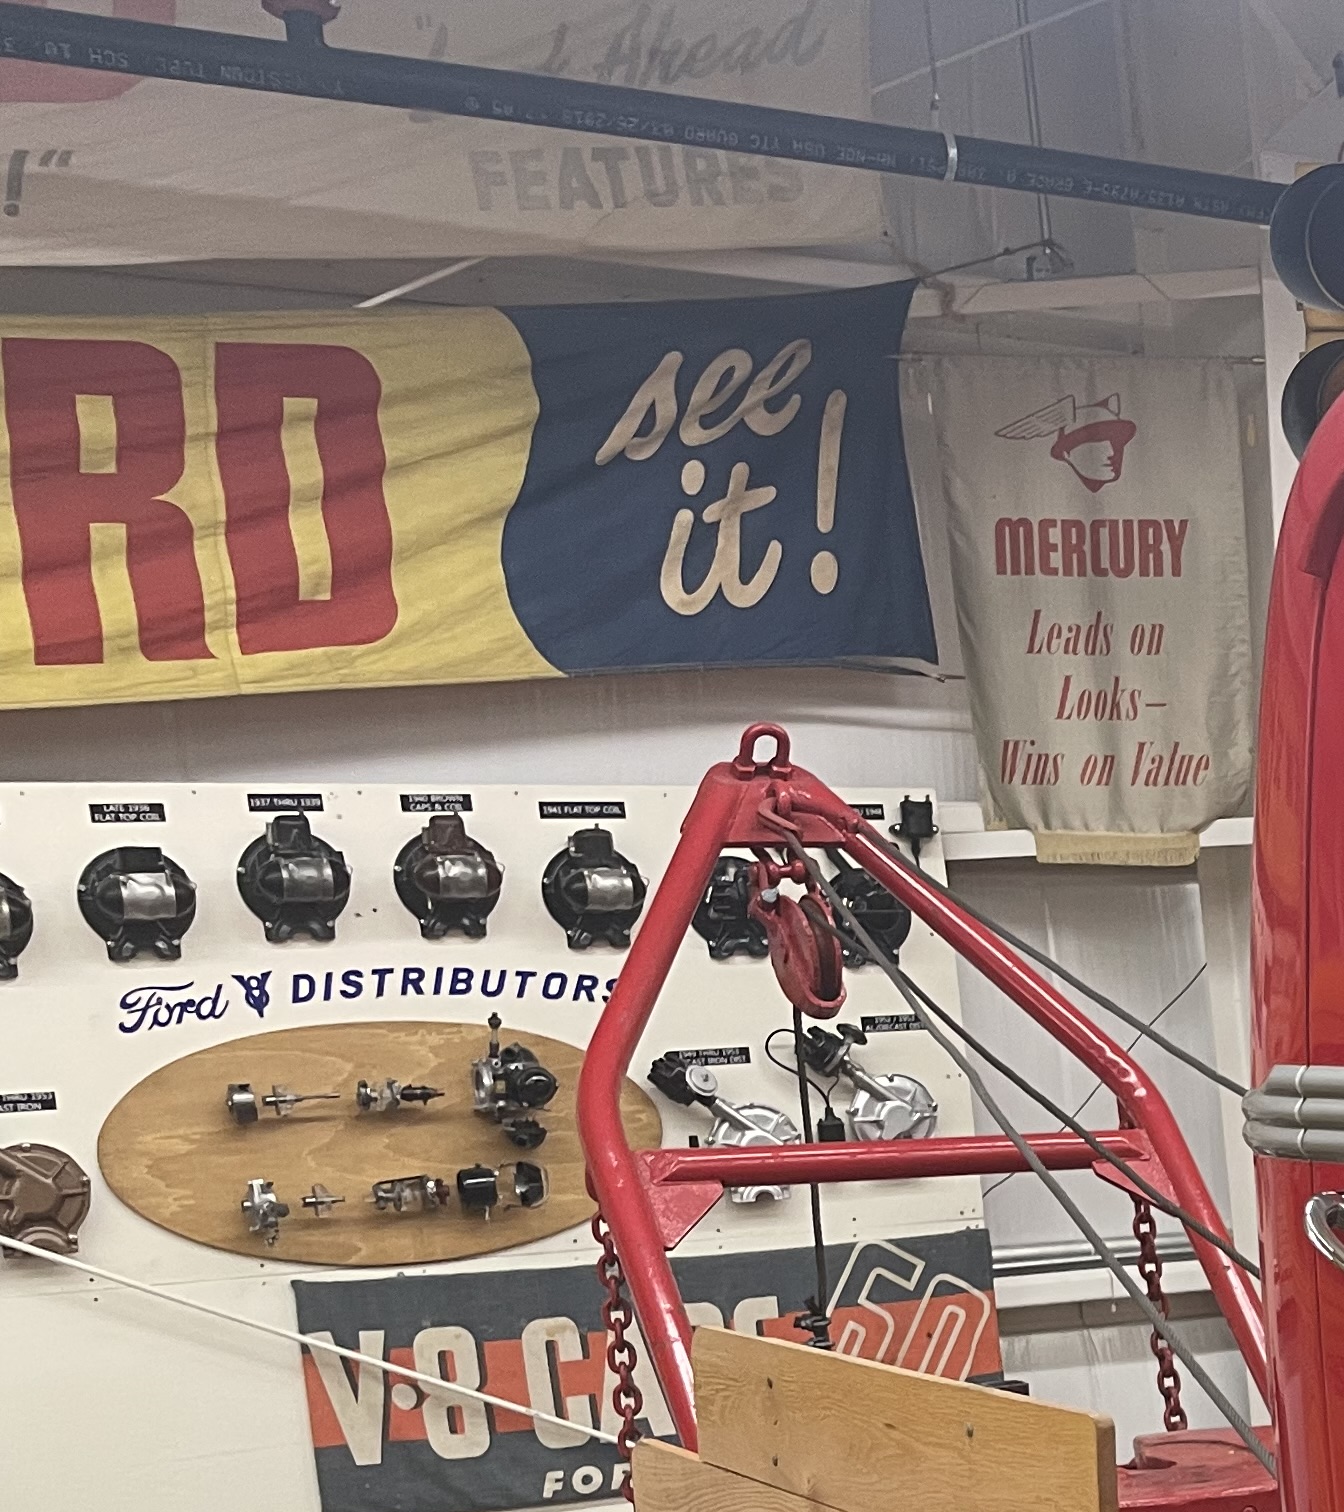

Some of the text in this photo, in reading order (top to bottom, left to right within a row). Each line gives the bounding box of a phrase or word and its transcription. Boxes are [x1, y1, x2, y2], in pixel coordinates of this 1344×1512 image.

[468, 146, 804, 212] FEATURES
[595, 338, 813, 466] see
[659, 388, 848, 618] it!
[994, 517, 1189, 578] MERCURY
[1025, 609, 1164, 656] Leads on
[1000, 739, 1211, 787] Wins on Value
[119, 813, 138, 822] TOP
[564, 805, 583, 814] FLAT
[584, 805, 601, 814] TOP
[118, 981, 228, 1034] Ford
